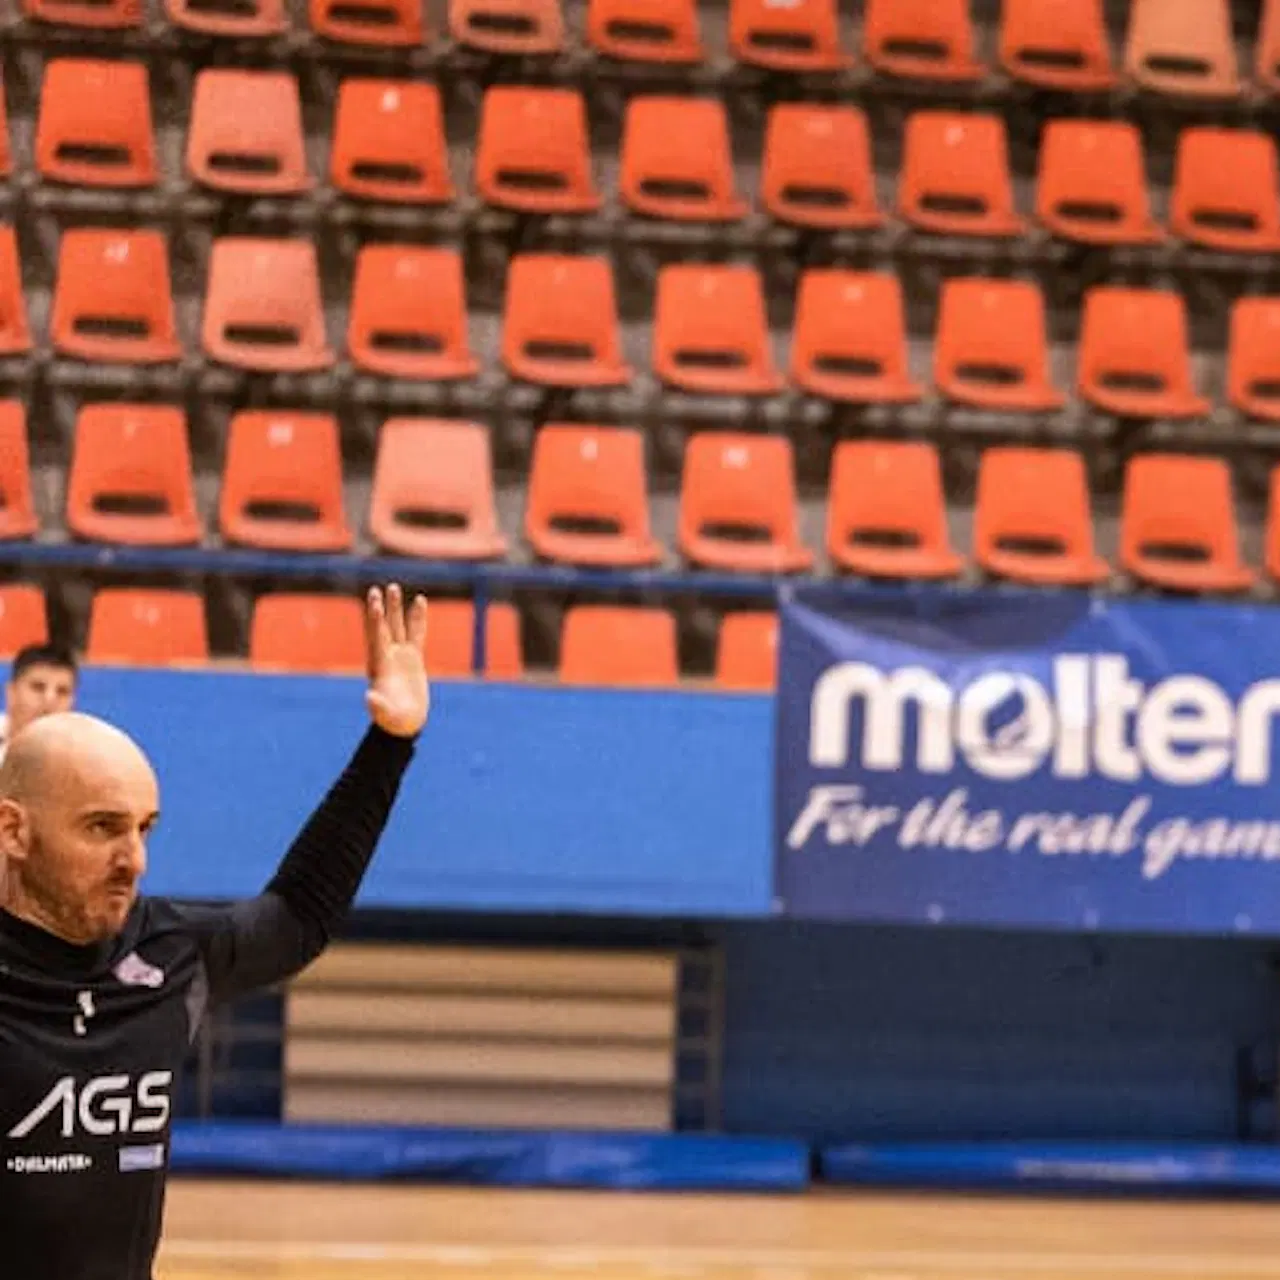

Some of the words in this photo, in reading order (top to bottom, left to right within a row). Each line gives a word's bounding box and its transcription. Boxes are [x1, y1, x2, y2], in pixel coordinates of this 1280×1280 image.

[788, 785, 897, 849] For
[899, 788, 1002, 852] the
[1007, 796, 1151, 857] real
[8, 1070, 172, 1138] AGS
